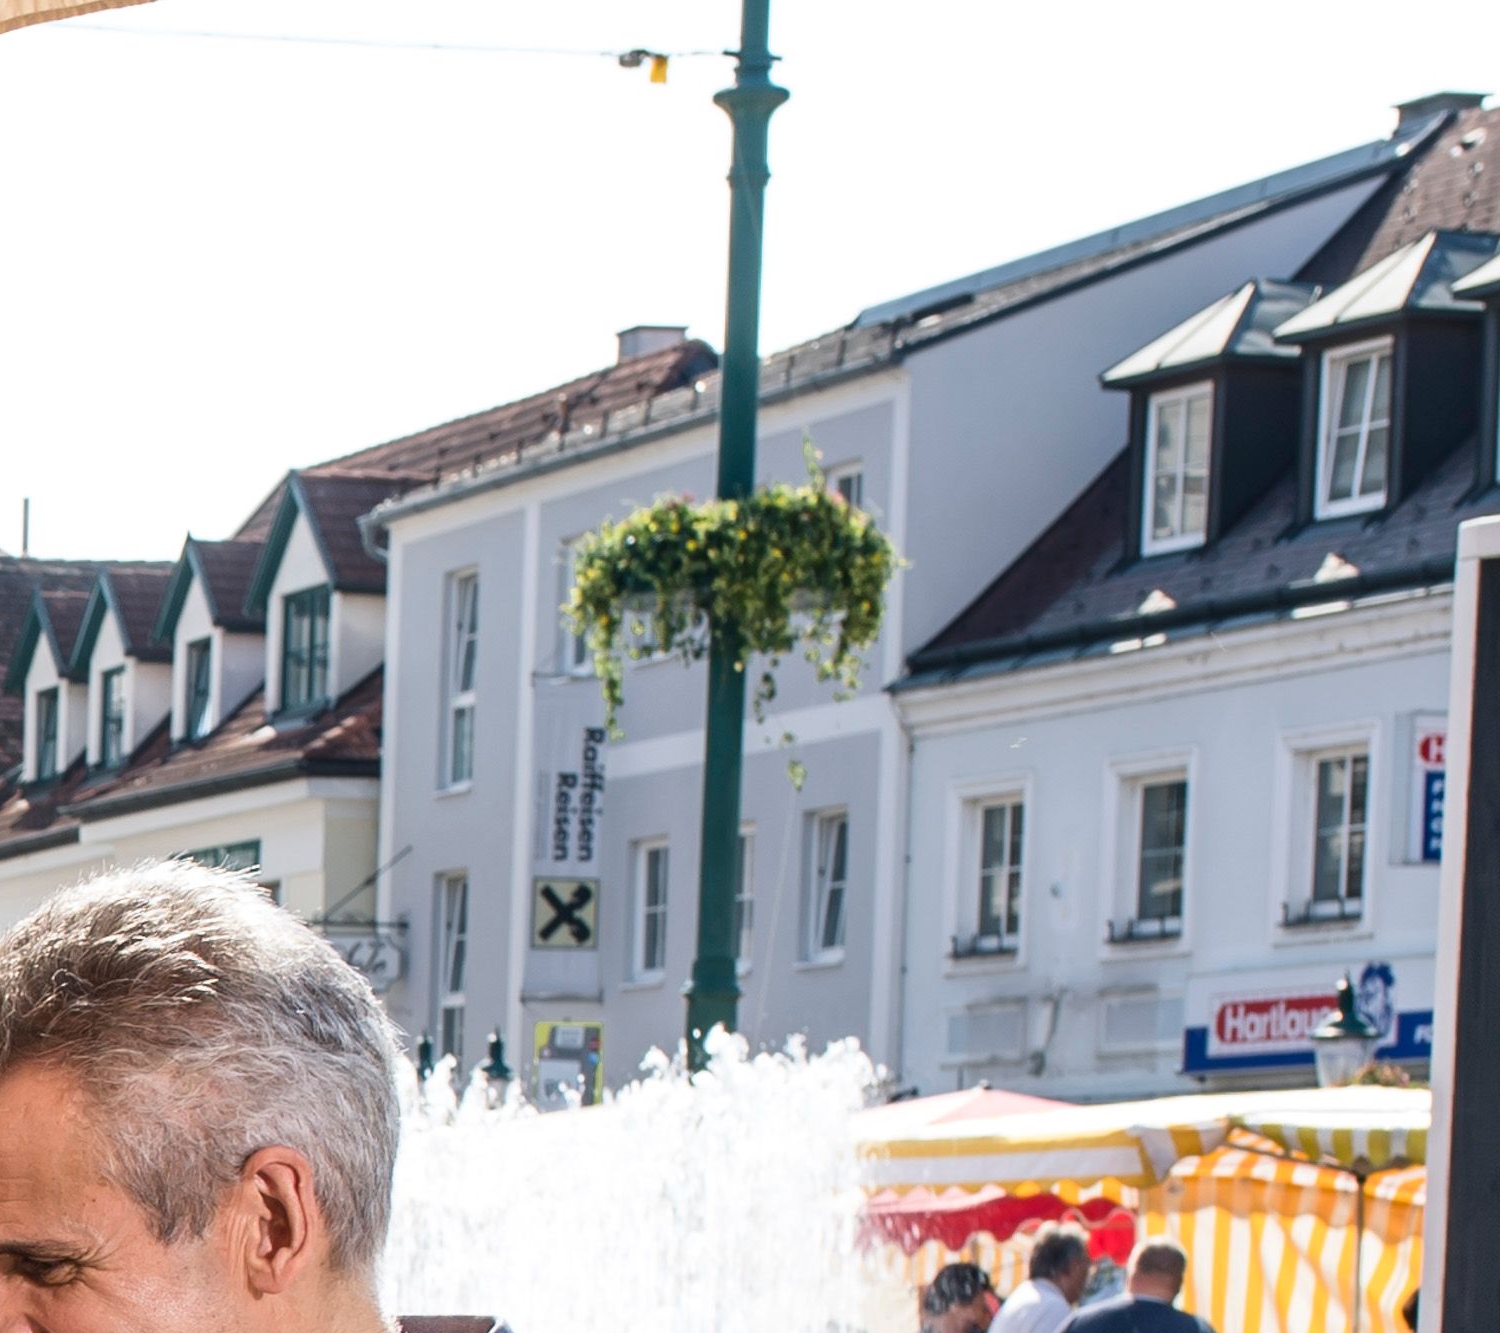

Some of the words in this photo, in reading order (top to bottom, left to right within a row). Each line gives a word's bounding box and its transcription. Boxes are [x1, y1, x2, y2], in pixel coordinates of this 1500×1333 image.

[553, 771, 579, 862] Reisen
[577, 726, 606, 862] Raiffeisen
[1222, 1002, 1336, 1042] Hartlau
